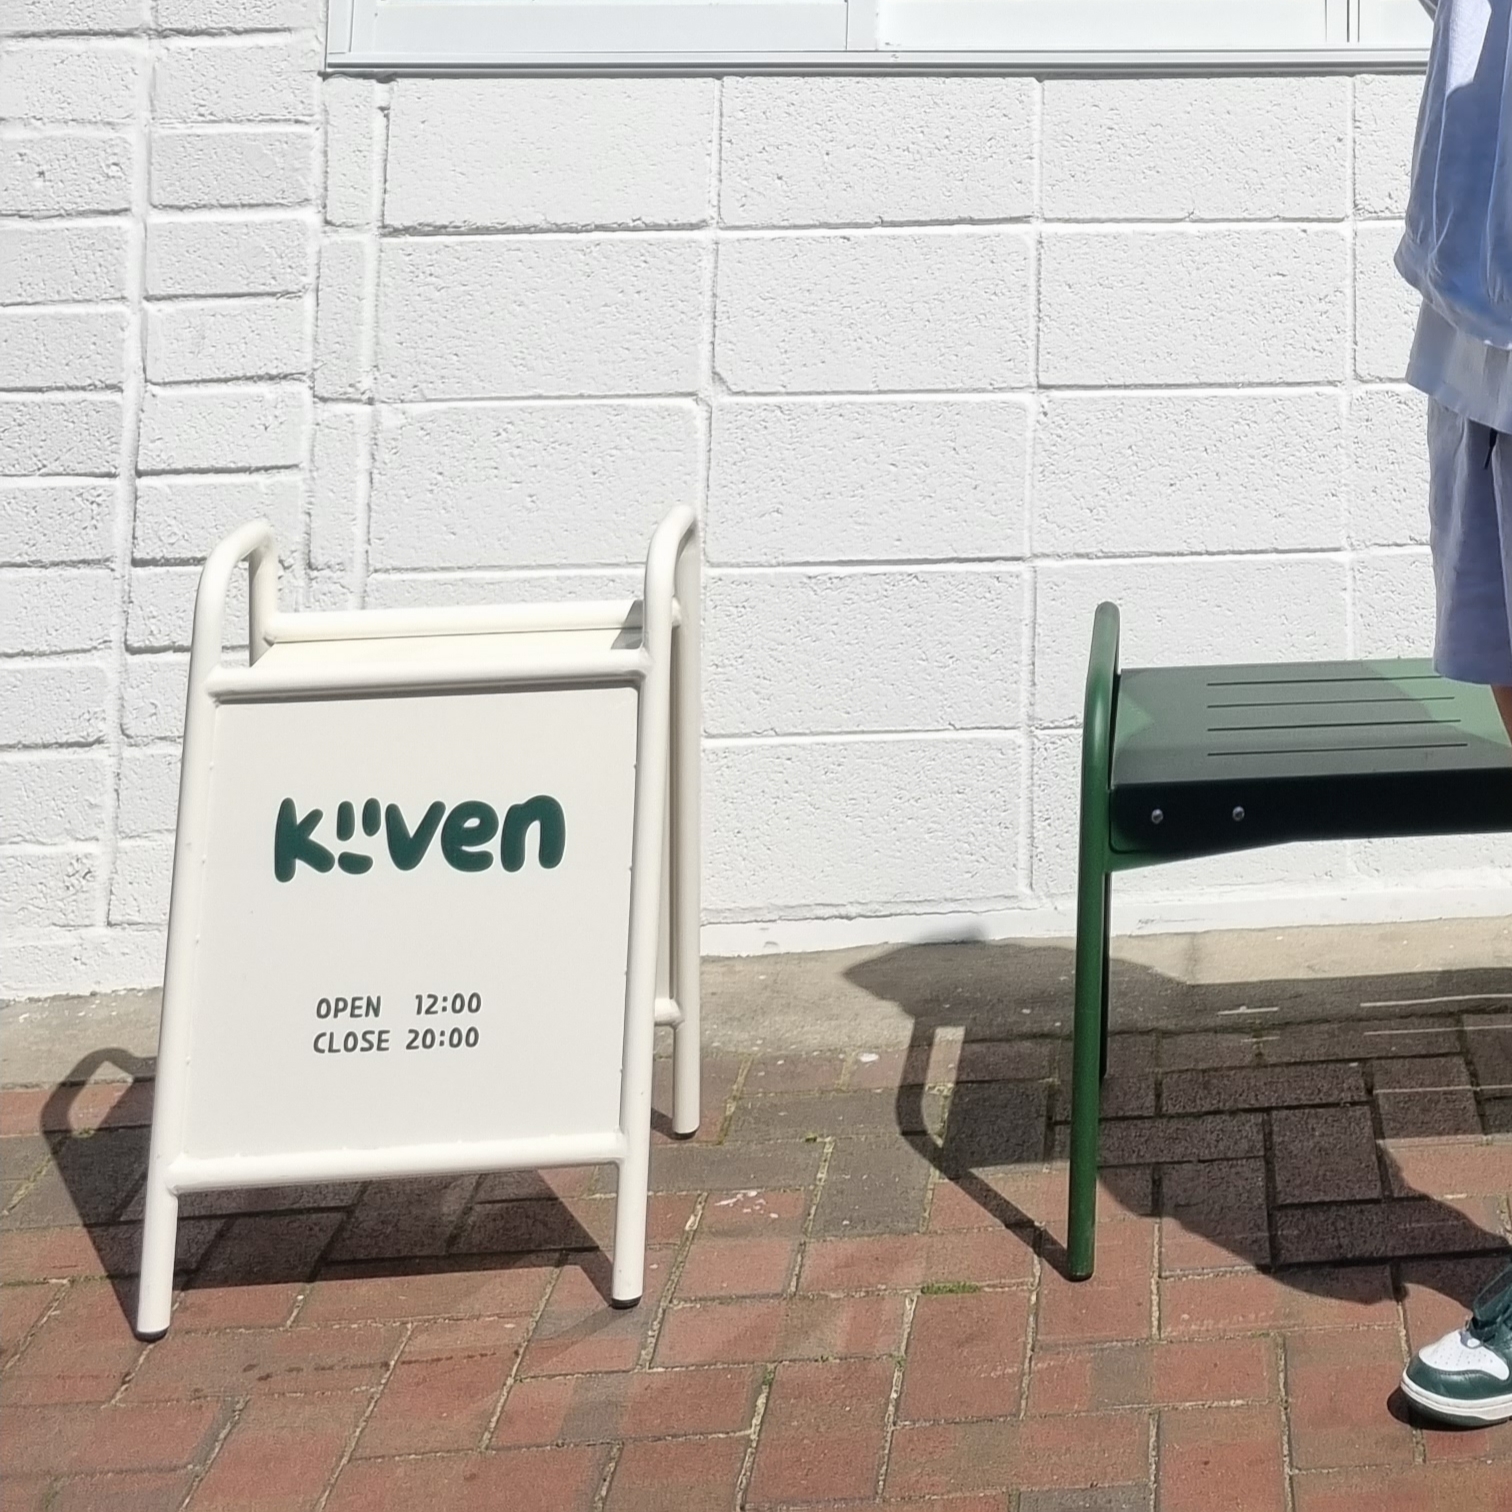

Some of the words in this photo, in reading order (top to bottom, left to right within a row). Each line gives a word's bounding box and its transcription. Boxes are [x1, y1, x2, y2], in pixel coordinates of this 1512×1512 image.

[316, 995, 381, 1019] OPEN
[415, 992, 482, 1016] 12:00
[313, 1029, 390, 1054] CLOSE
[405, 1026, 479, 1050] 20:00
